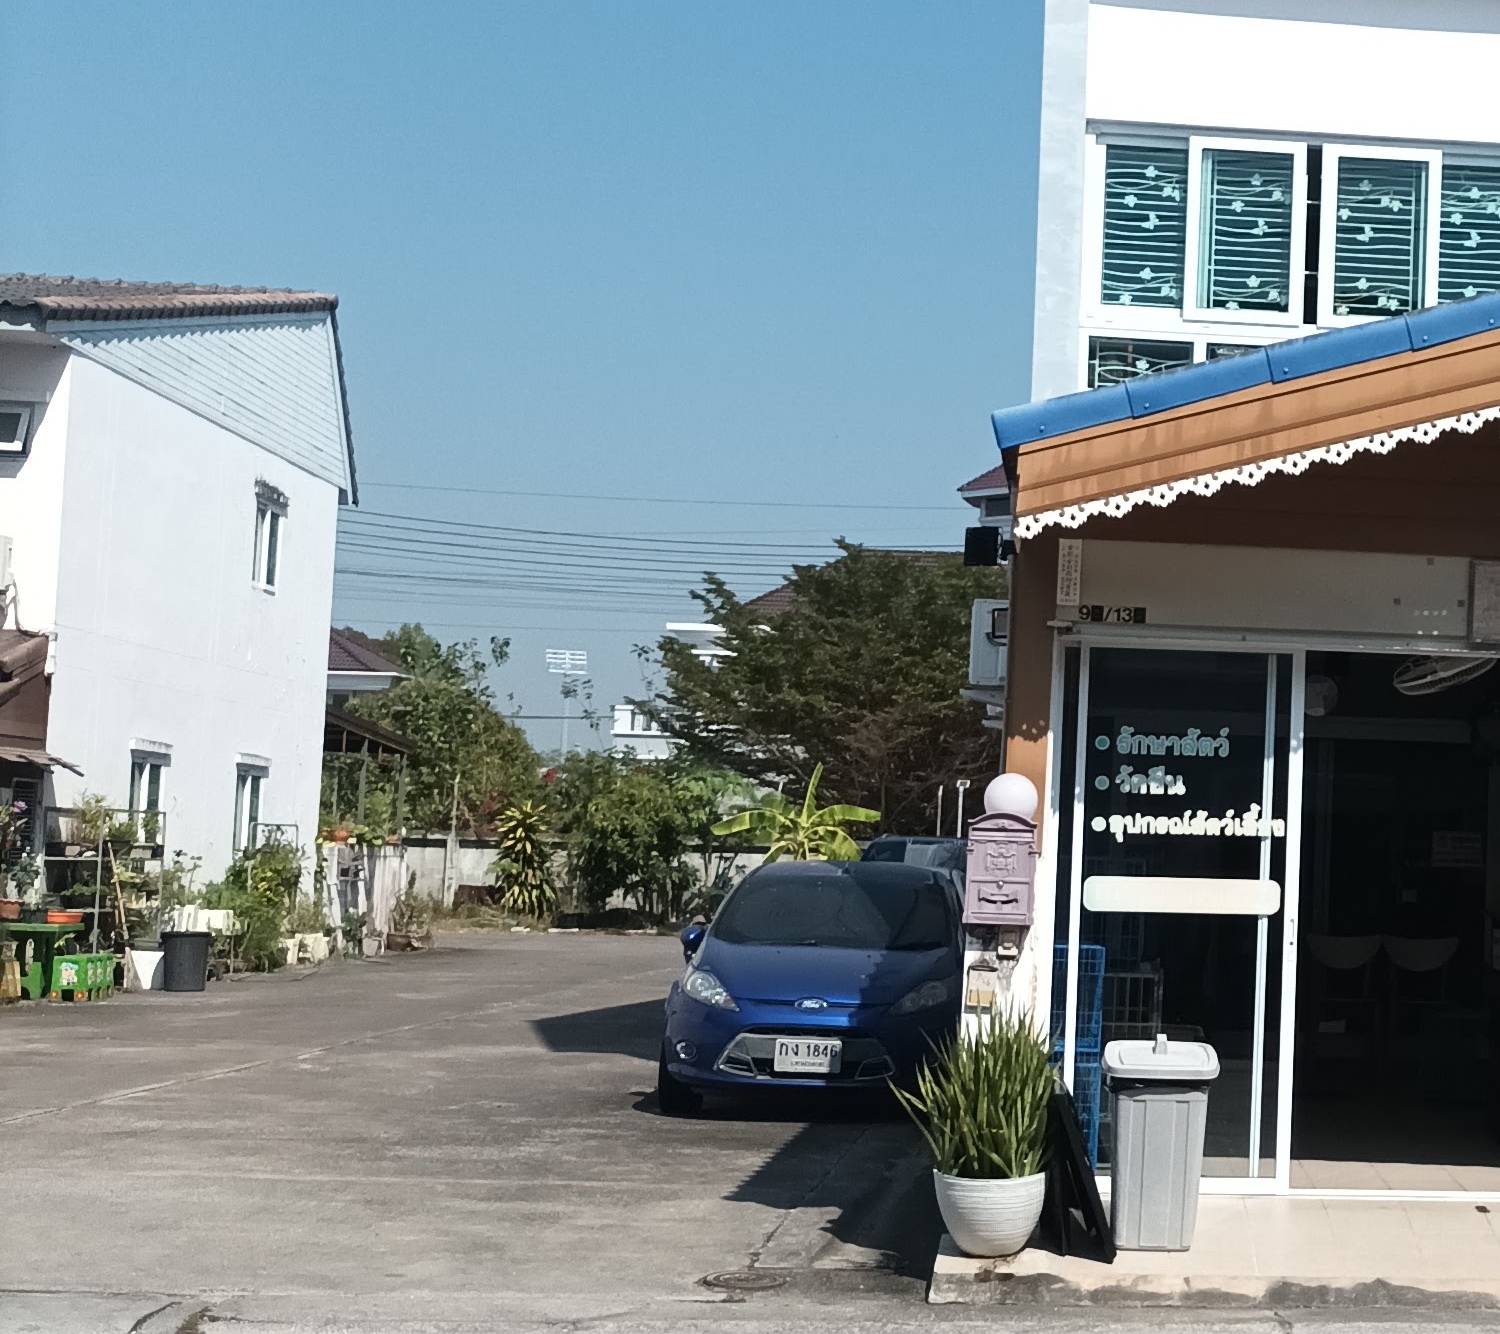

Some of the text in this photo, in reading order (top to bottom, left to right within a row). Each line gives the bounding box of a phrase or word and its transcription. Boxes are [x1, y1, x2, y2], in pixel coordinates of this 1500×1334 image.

[1078, 604, 1147, 624] 9/13
[1116, 725, 1230, 757] รักษาสัตว์
[807, 1043, 838, 1058] 1846
